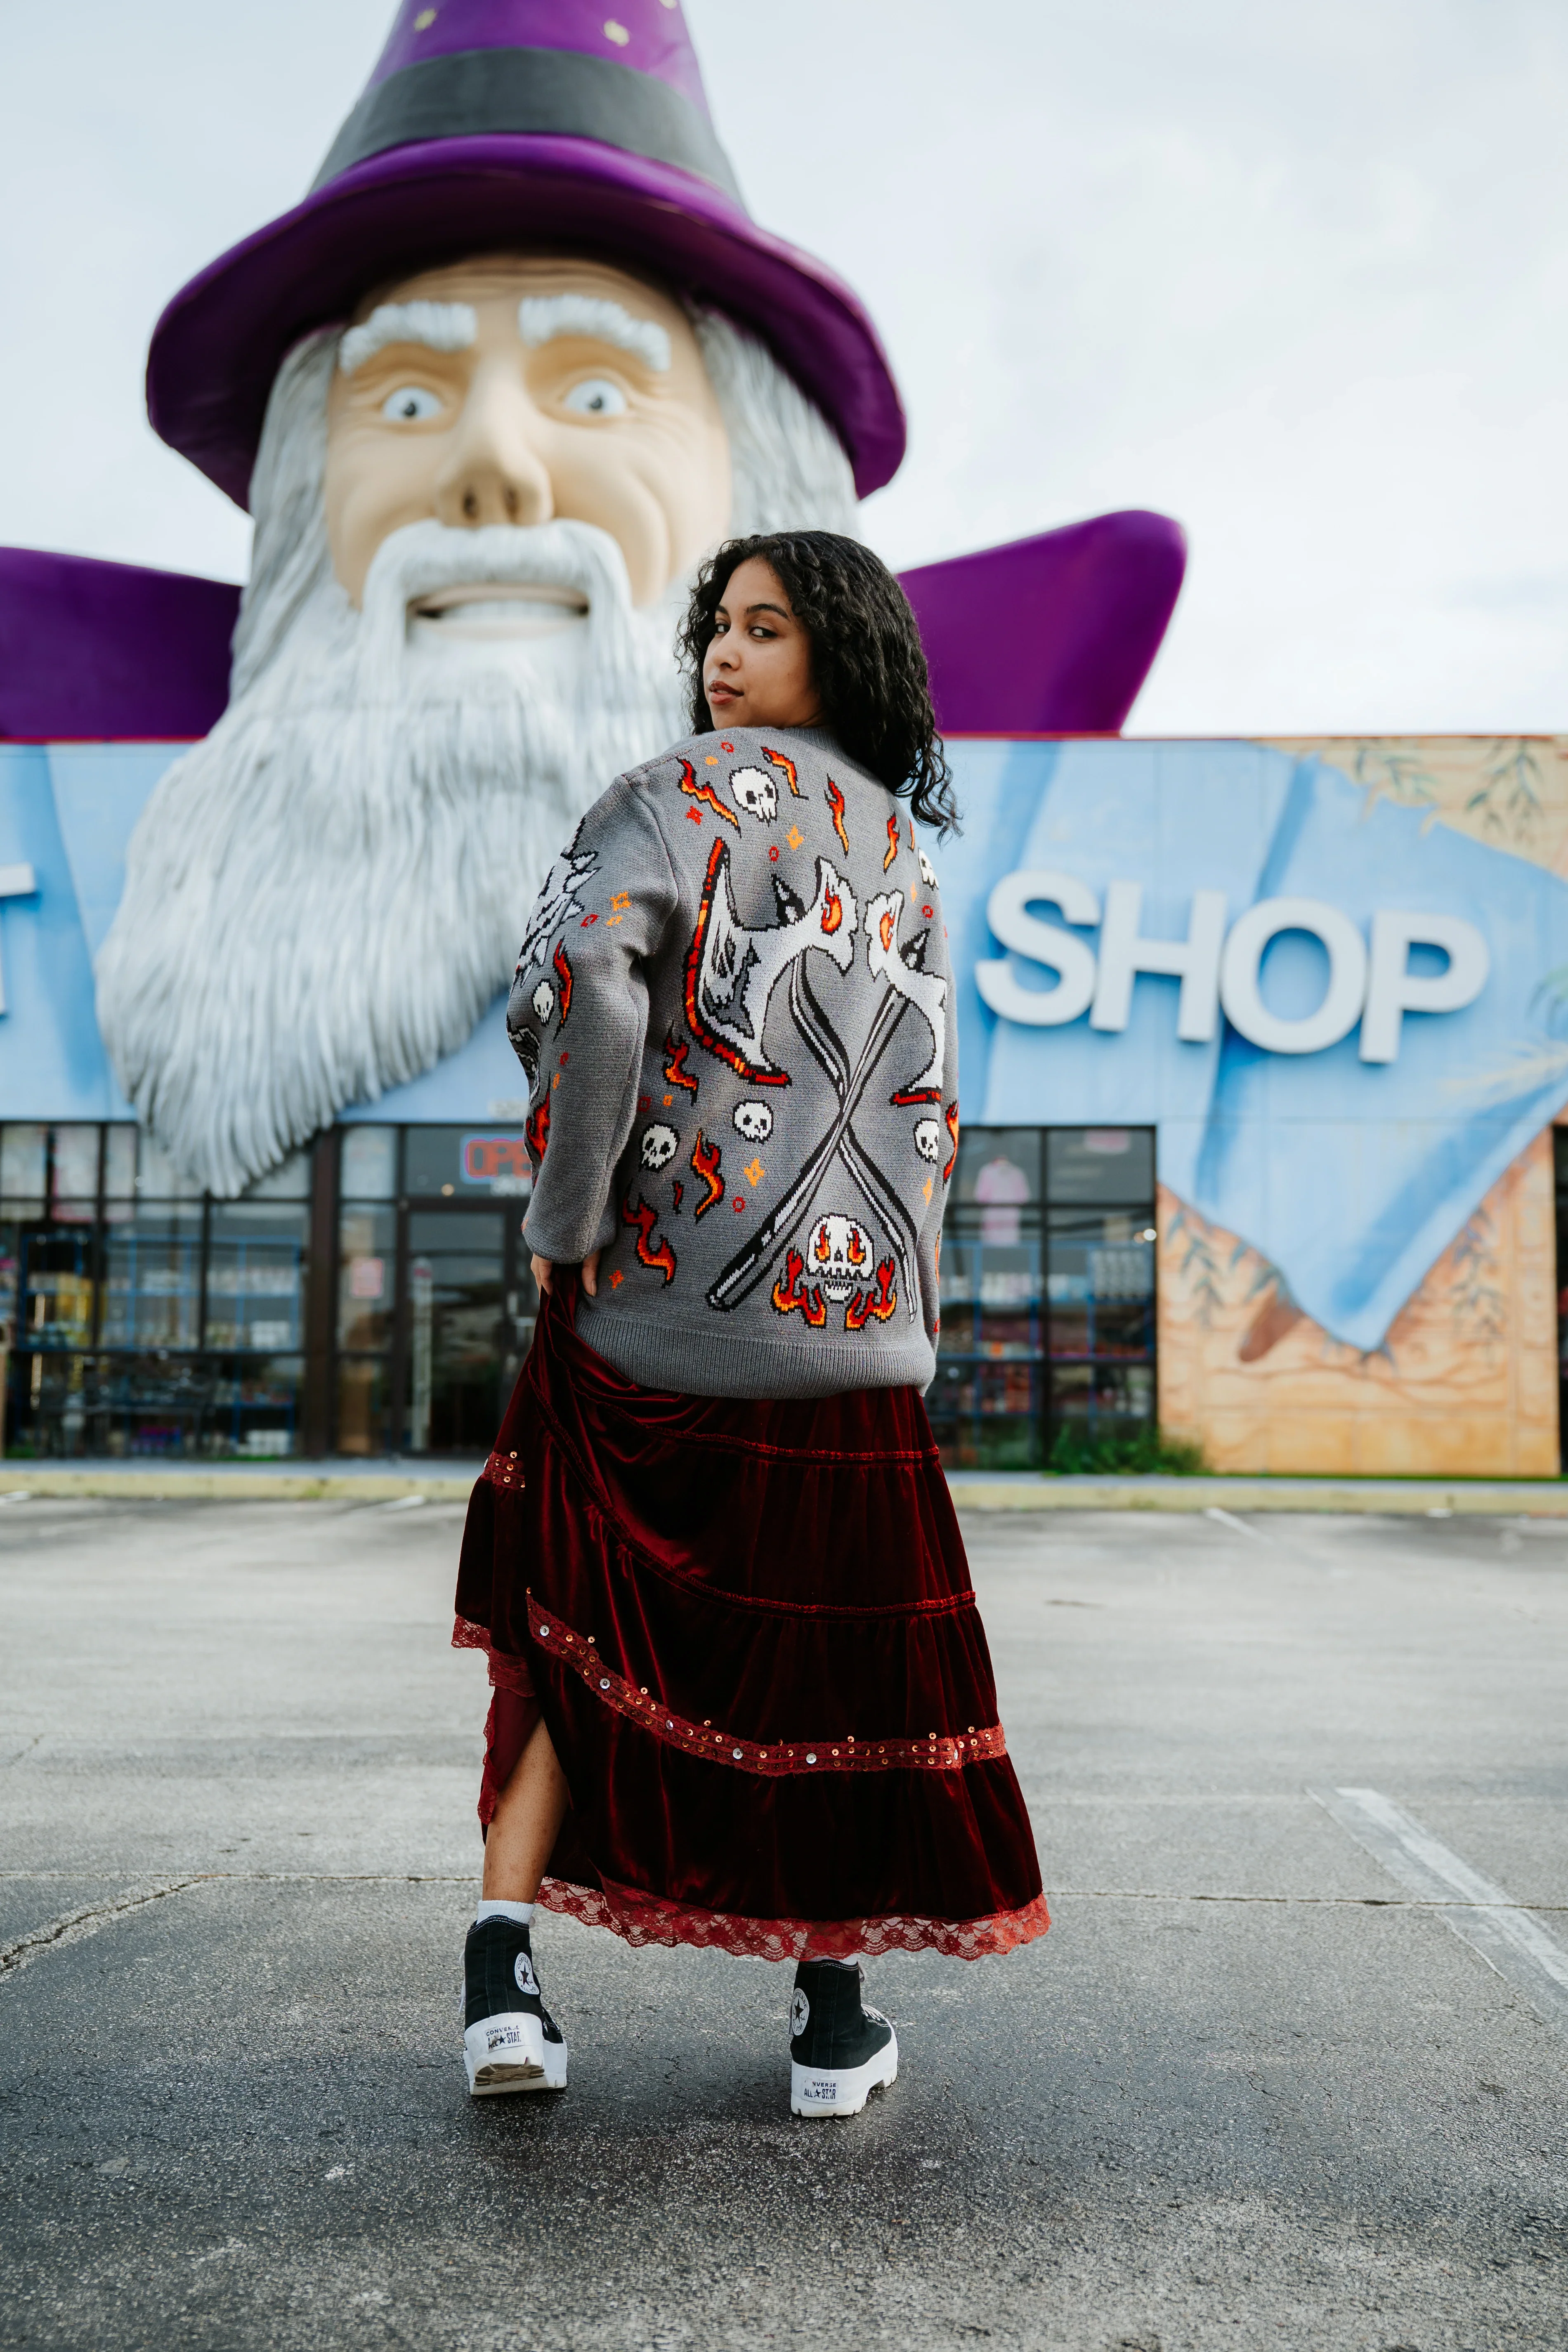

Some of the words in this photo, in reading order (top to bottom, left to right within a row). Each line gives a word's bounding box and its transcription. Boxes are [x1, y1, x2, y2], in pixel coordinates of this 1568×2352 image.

[975, 870, 1490, 1063] SHOP
[465, 1139, 532, 1179] OPE
[804, 2088, 813, 2097] ALL
[822, 2088, 836, 2099] STAR
